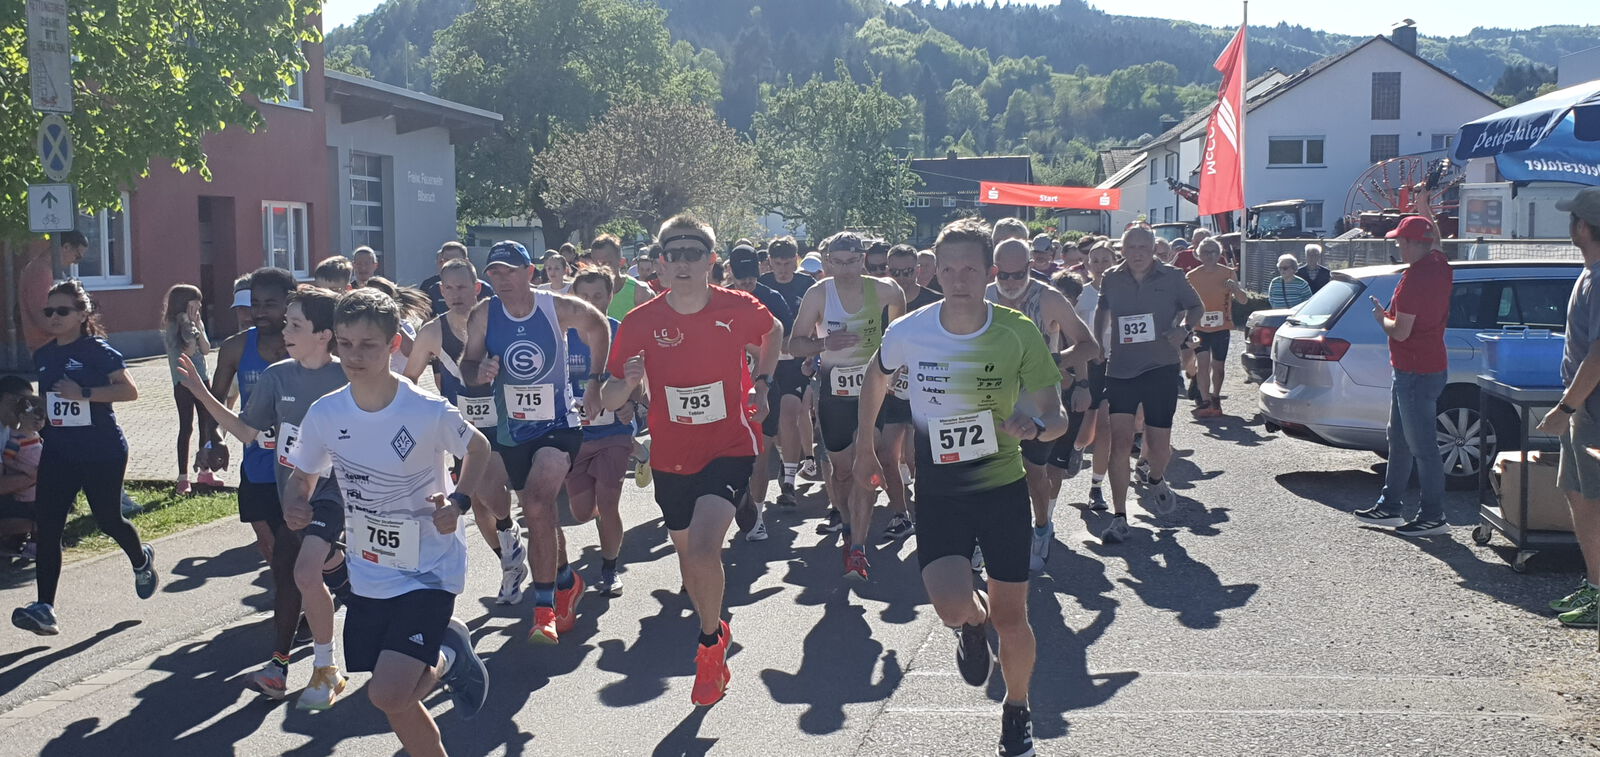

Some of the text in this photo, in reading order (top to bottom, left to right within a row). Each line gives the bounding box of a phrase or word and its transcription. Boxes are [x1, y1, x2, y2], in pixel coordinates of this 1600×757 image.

[1039, 194, 1059, 202] Start
[1125, 321, 1147, 336] 932
[837, 373, 863, 388] 910
[895, 378, 908, 390] 20
[515, 393, 542, 406] 715
[679, 394, 710, 410] 793
[53, 401, 80, 416] 876
[466, 404, 489, 416] 832
[939, 424, 984, 449] 572
[367, 525, 400, 549] 765
